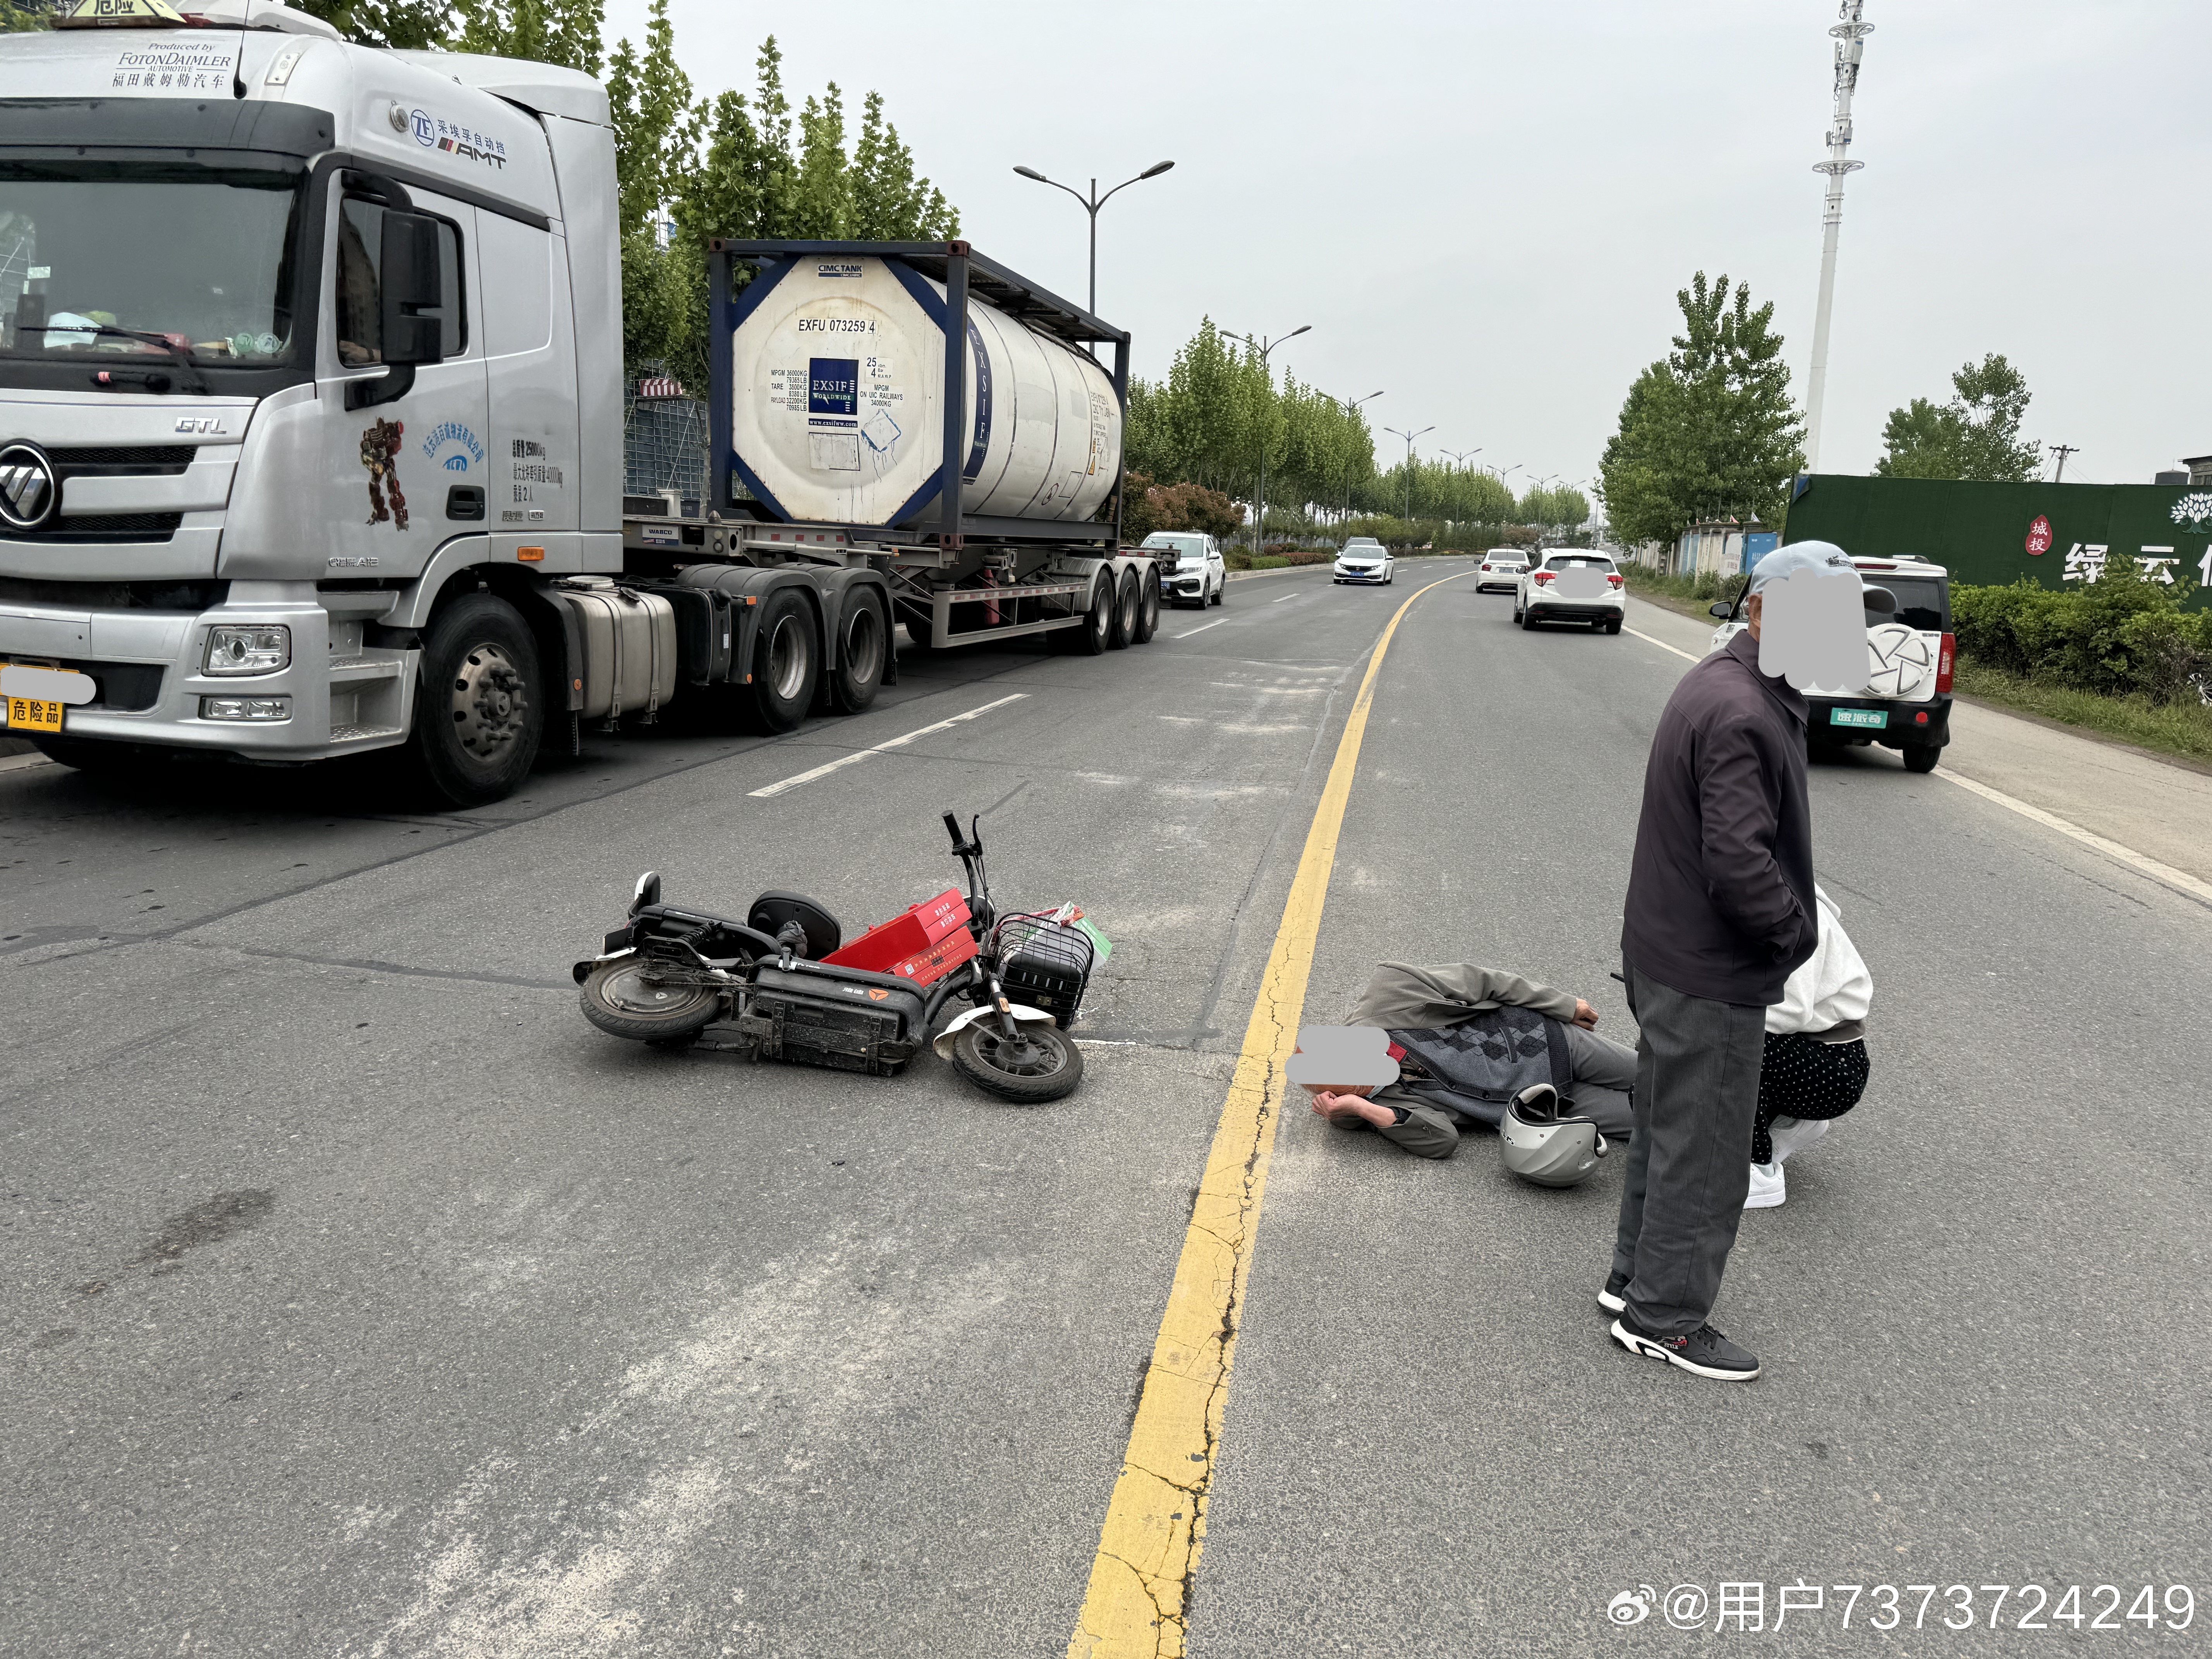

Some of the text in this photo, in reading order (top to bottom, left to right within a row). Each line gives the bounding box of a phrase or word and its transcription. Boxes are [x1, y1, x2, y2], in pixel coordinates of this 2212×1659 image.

[201, 44, 215, 52] by
[112, 73, 223, 88] 福田戴姆勒汽车
[411, 114, 434, 142] ZF
[438, 119, 505, 155] 采埃孚自动挡
[455, 143, 507, 170] AMT
[799, 319, 875, 334] EXFU 073259 4
[867, 357, 876, 367] 25
[871, 368, 876, 378] 4
[813, 380, 847, 392] EXSIF
[970, 329, 986, 439] EXSIF
[879, 392, 903, 400] RAILWAYS
[175, 417, 227, 434] GTL
[2029, 521, 2048, 552] 城投
[2063, 543, 2212, 586] 绿云
[13, 700, 58, 724] 危险品
